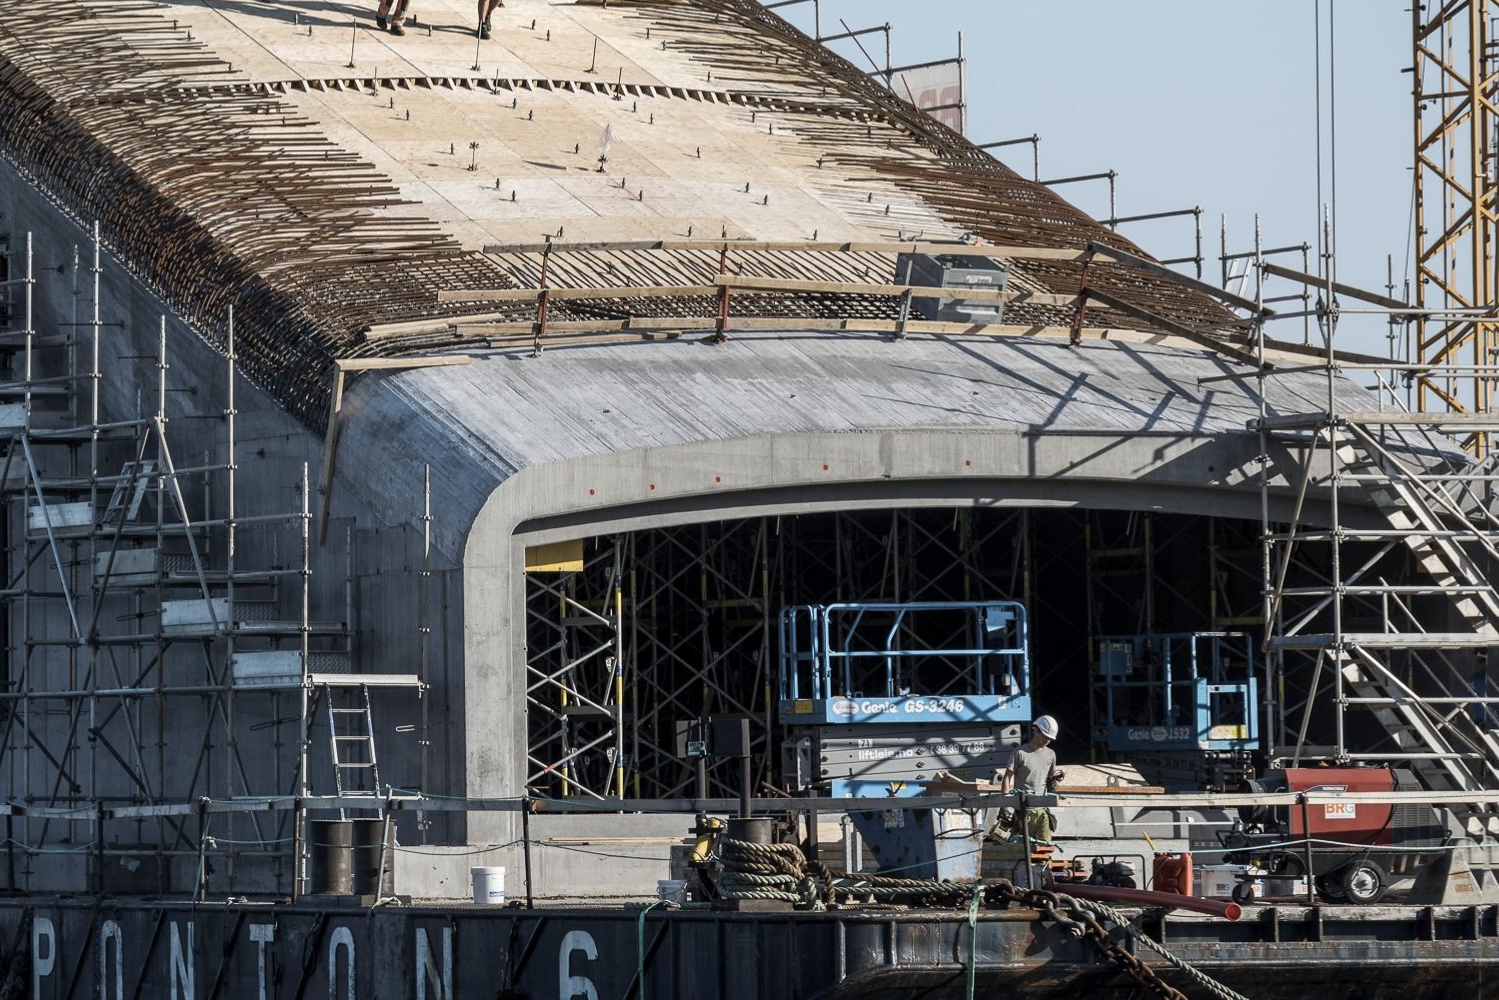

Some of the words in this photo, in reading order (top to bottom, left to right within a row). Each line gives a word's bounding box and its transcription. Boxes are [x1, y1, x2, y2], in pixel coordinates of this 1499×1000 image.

[862, 701, 898, 714] Genie
[905, 699, 964, 713] GS-3246
[1128, 728, 1150, 740] Genie
[1168, 727, 1190, 740] 1932
[858, 749, 914, 761] liftleie.no
